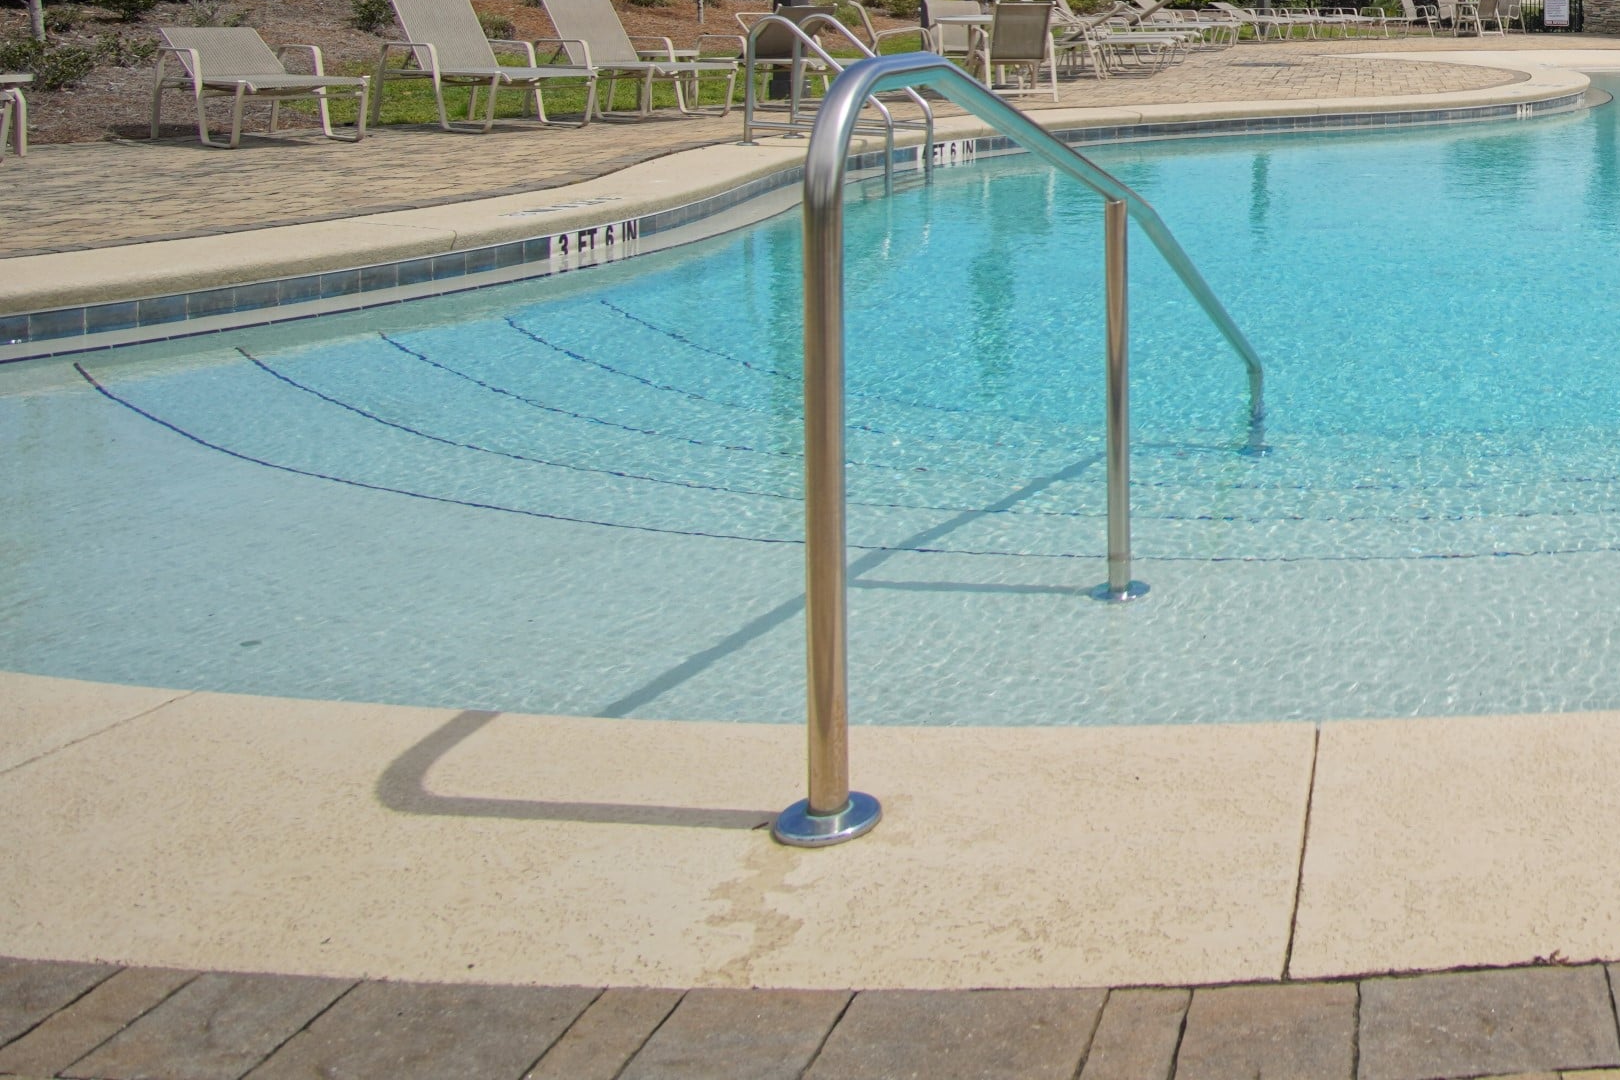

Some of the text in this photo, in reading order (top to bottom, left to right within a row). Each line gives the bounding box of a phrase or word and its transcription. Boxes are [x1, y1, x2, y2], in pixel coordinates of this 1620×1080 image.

[962, 139, 974, 154] IN
[559, 220, 638, 255] 3 FT 6 IN
